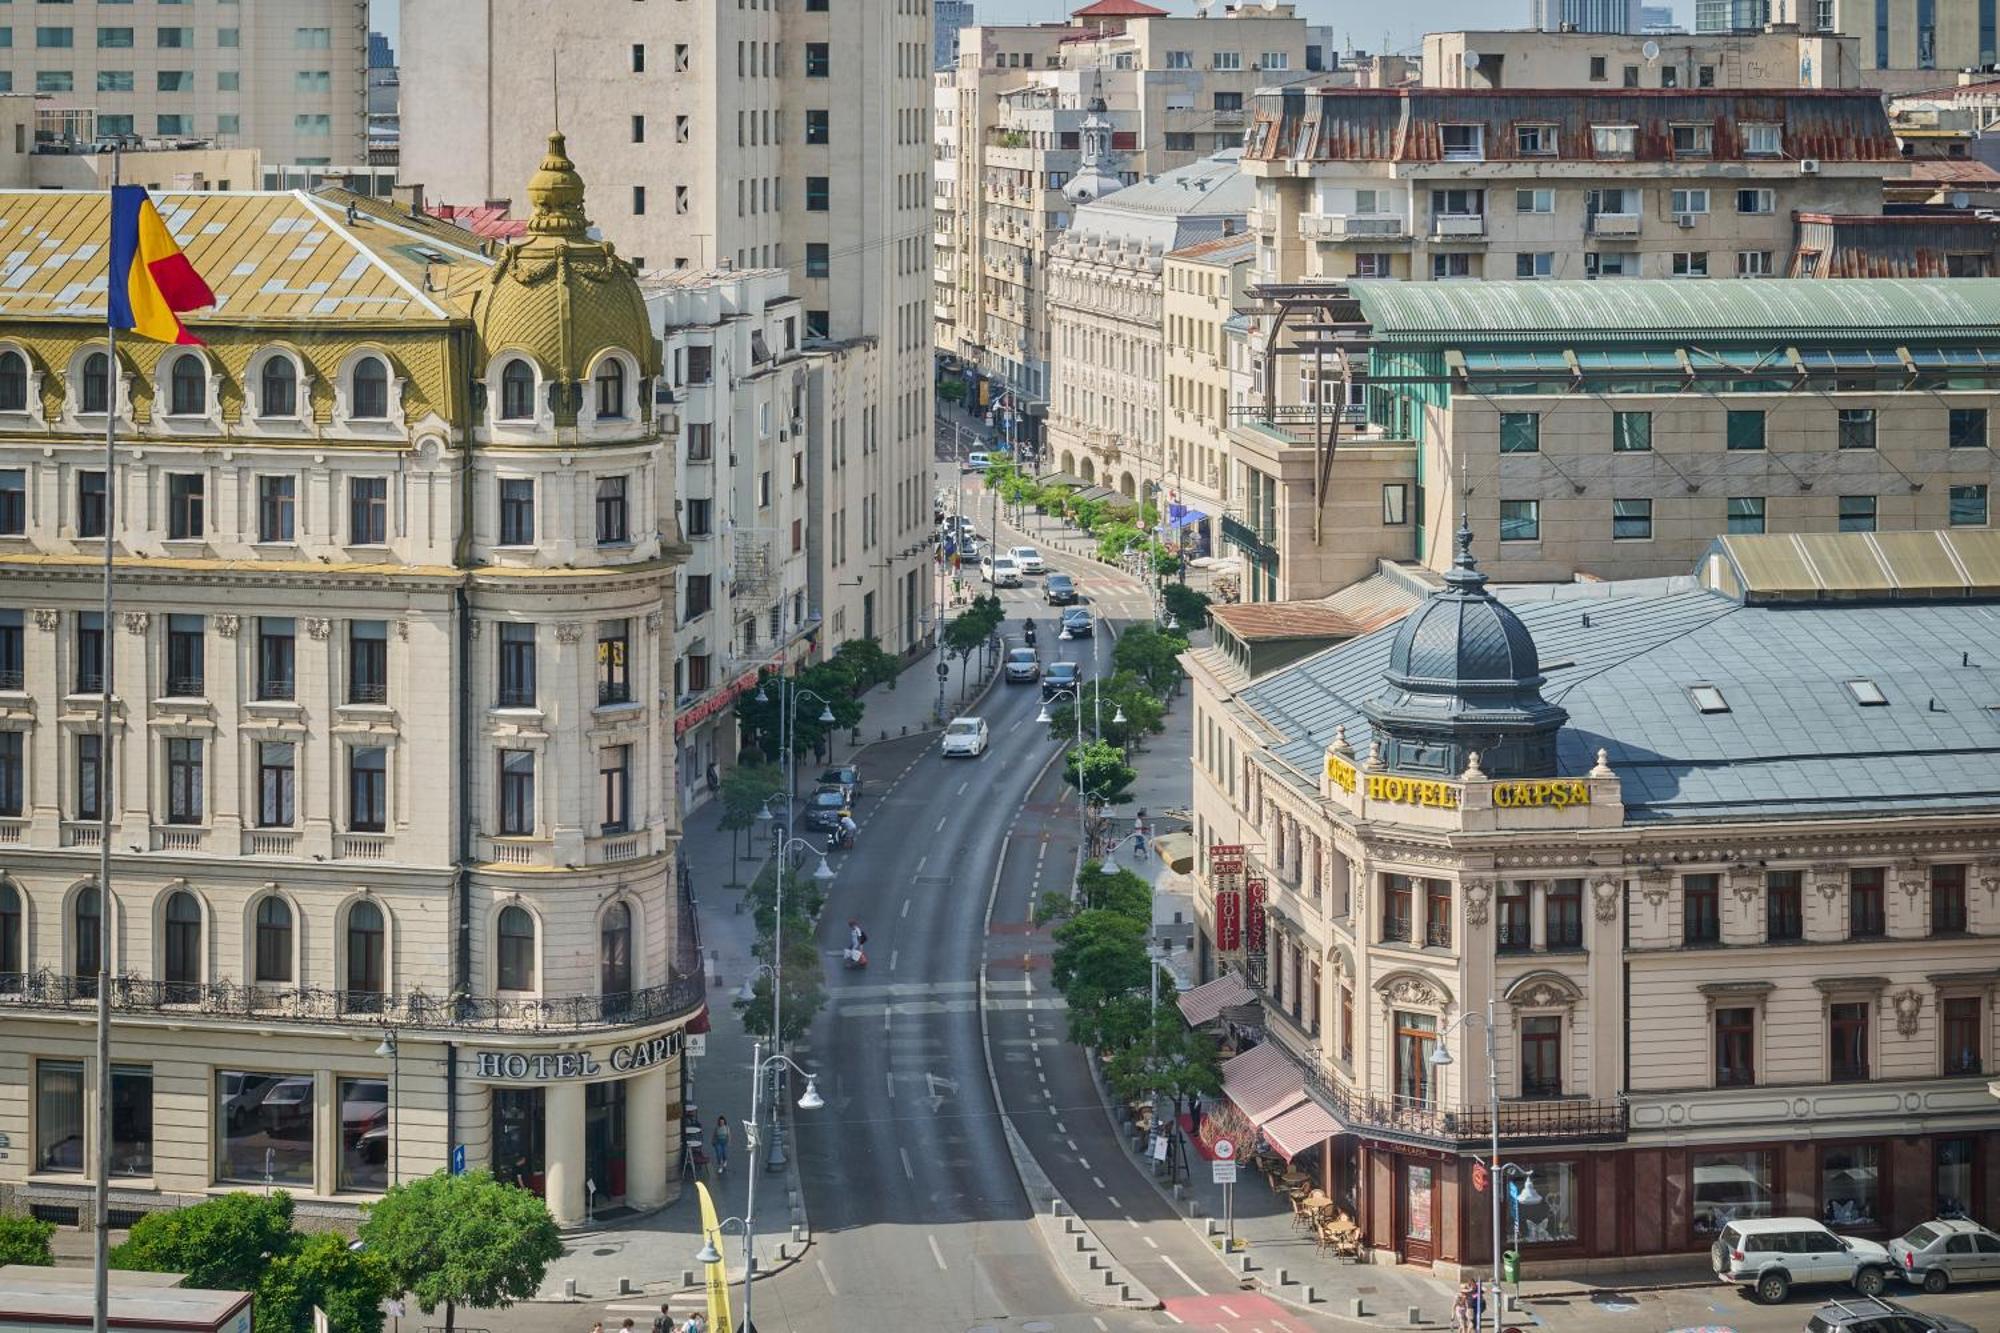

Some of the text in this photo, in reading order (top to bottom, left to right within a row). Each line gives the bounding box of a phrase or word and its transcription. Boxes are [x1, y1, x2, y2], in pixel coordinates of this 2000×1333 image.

[1369, 778, 1456, 807] HOTEL
[1223, 892, 1235, 952] HOTEL
[477, 1052, 600, 1079] HOTEL
